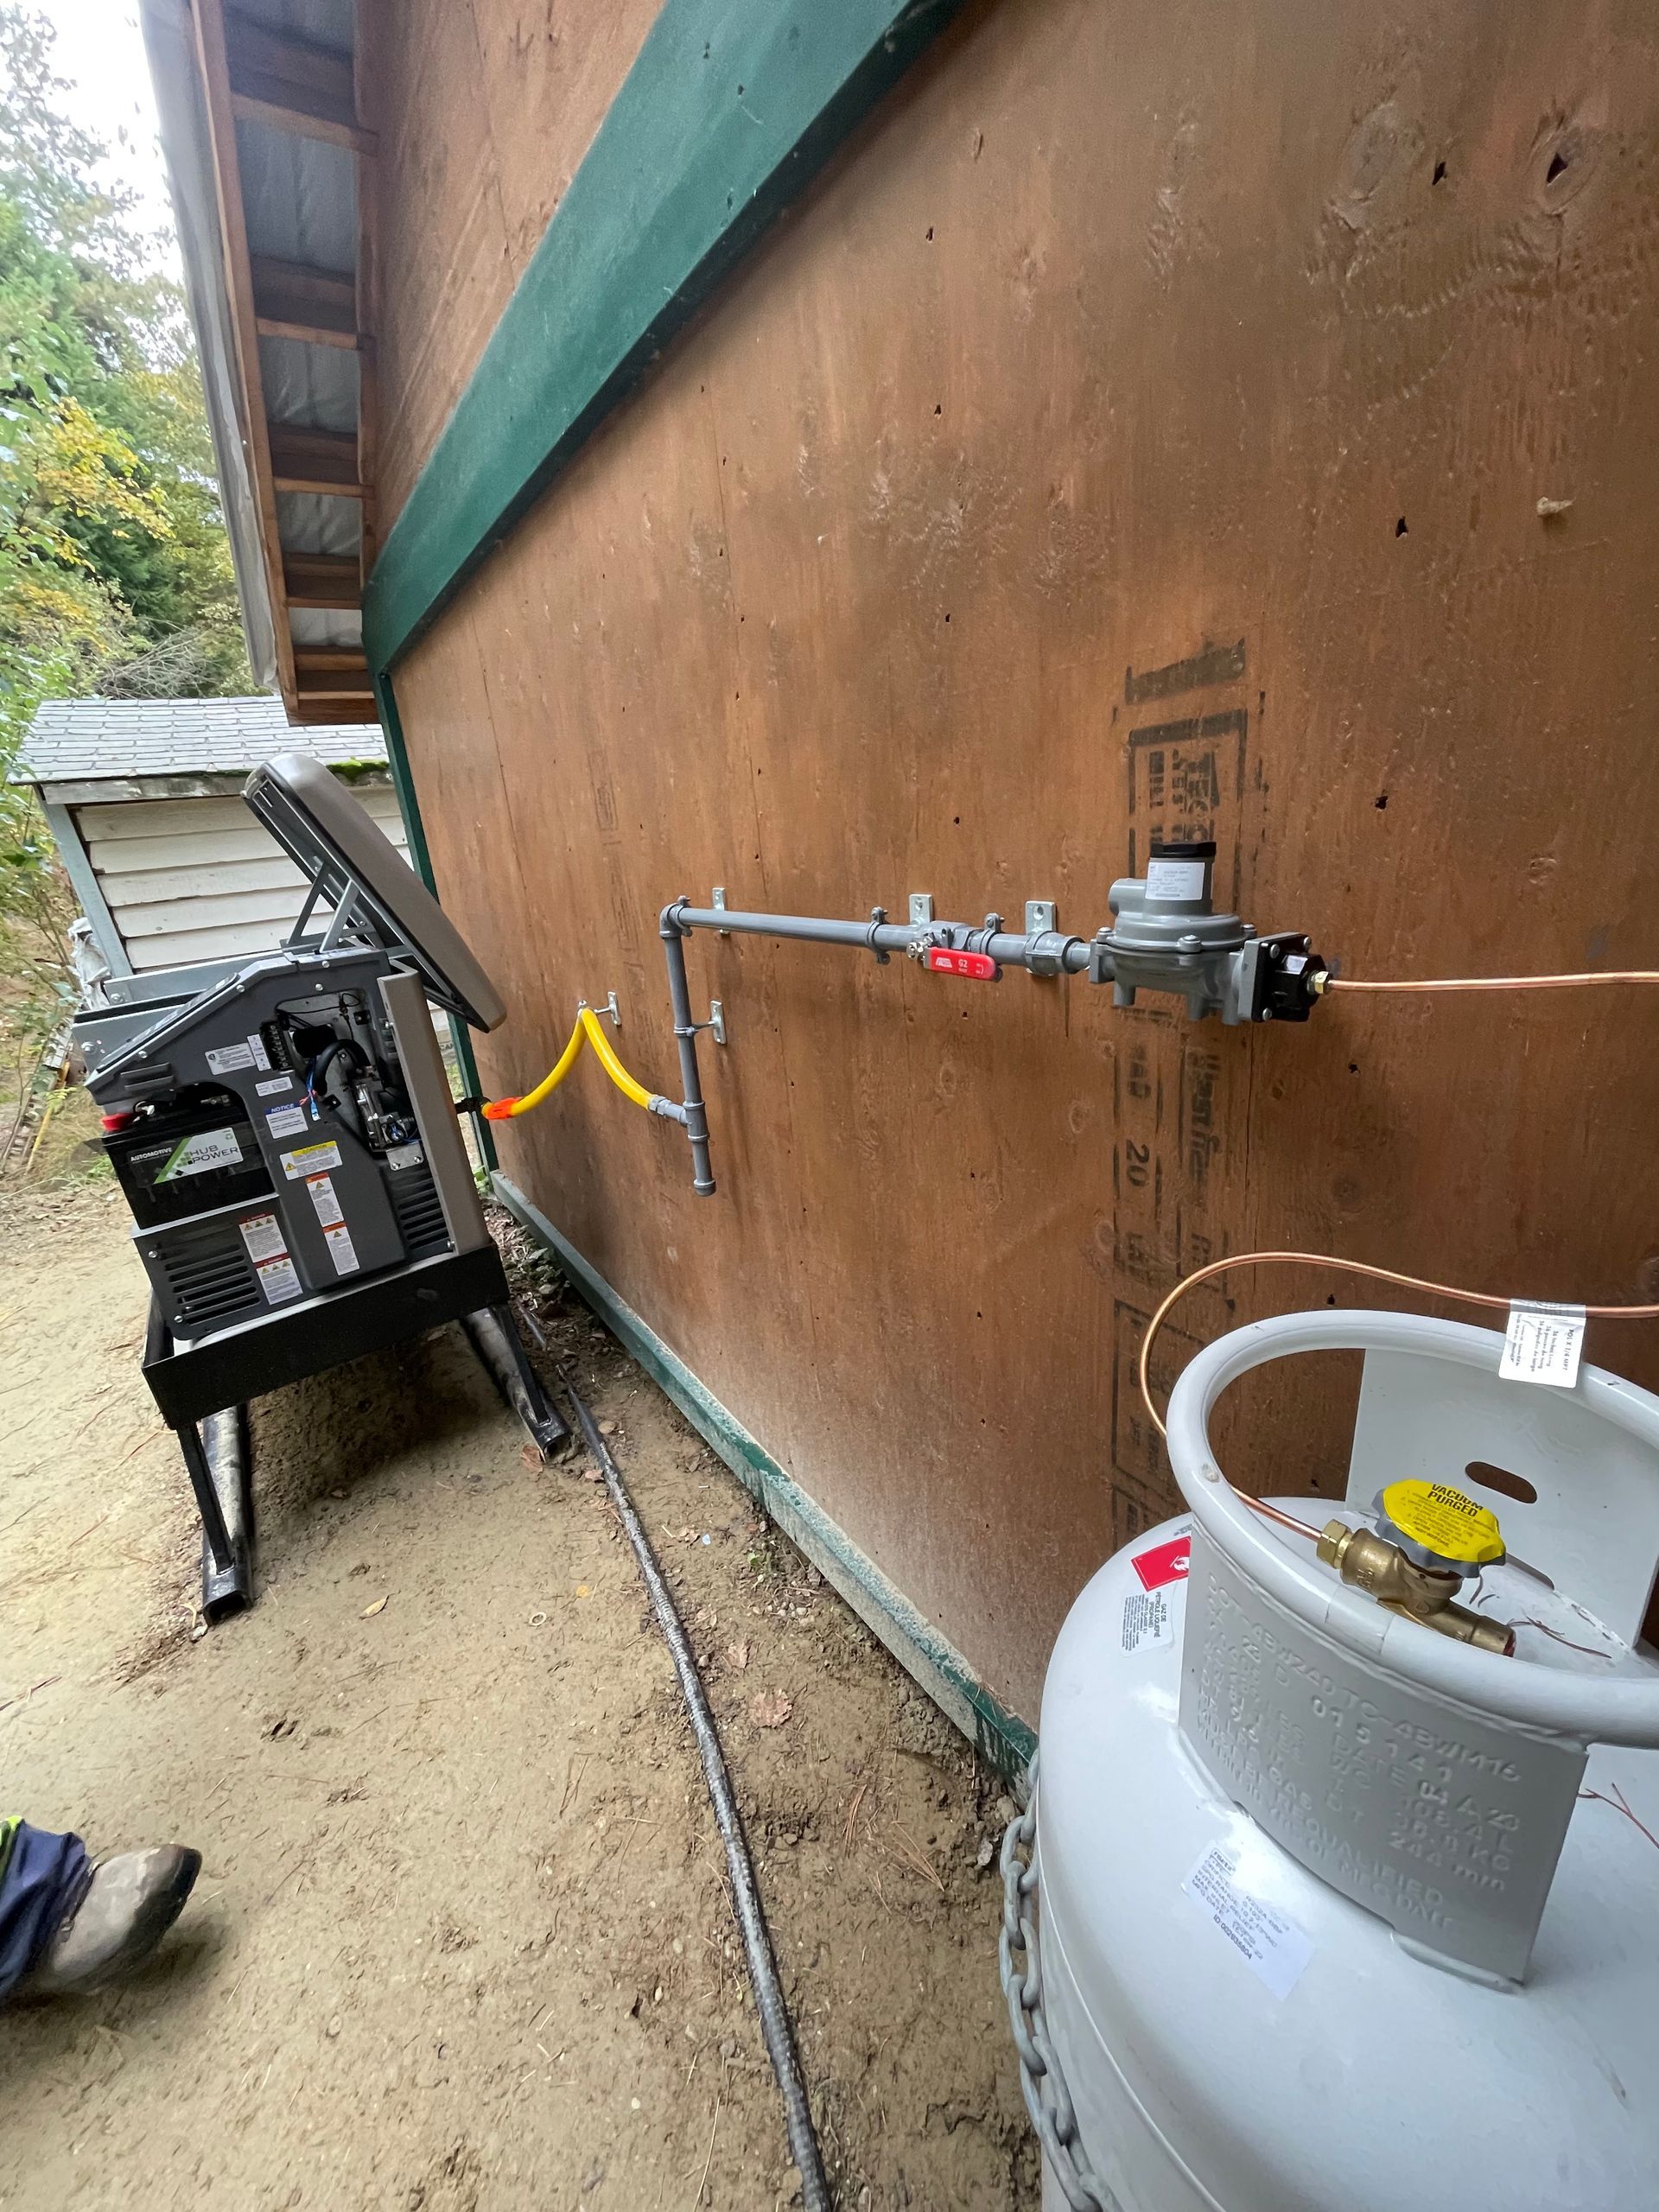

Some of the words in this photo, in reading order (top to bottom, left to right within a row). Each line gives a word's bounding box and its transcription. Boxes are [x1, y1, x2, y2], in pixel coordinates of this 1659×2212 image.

[270, 1103, 295, 1114] NOTICE
[130, 1147, 172, 1162] AUTOMOTIVE
[189, 1144, 219, 1156] HUB
[192, 1147, 238, 1164] POWER
[1127, 1139, 1151, 1188] 20
[1427, 1491, 1478, 1517] PURGED
[1432, 1484, 1484, 1510] VACUUM
[1336, 1732, 1408, 1785] DATE
[1272, 1789, 1445, 1905] REQUALIFIED
